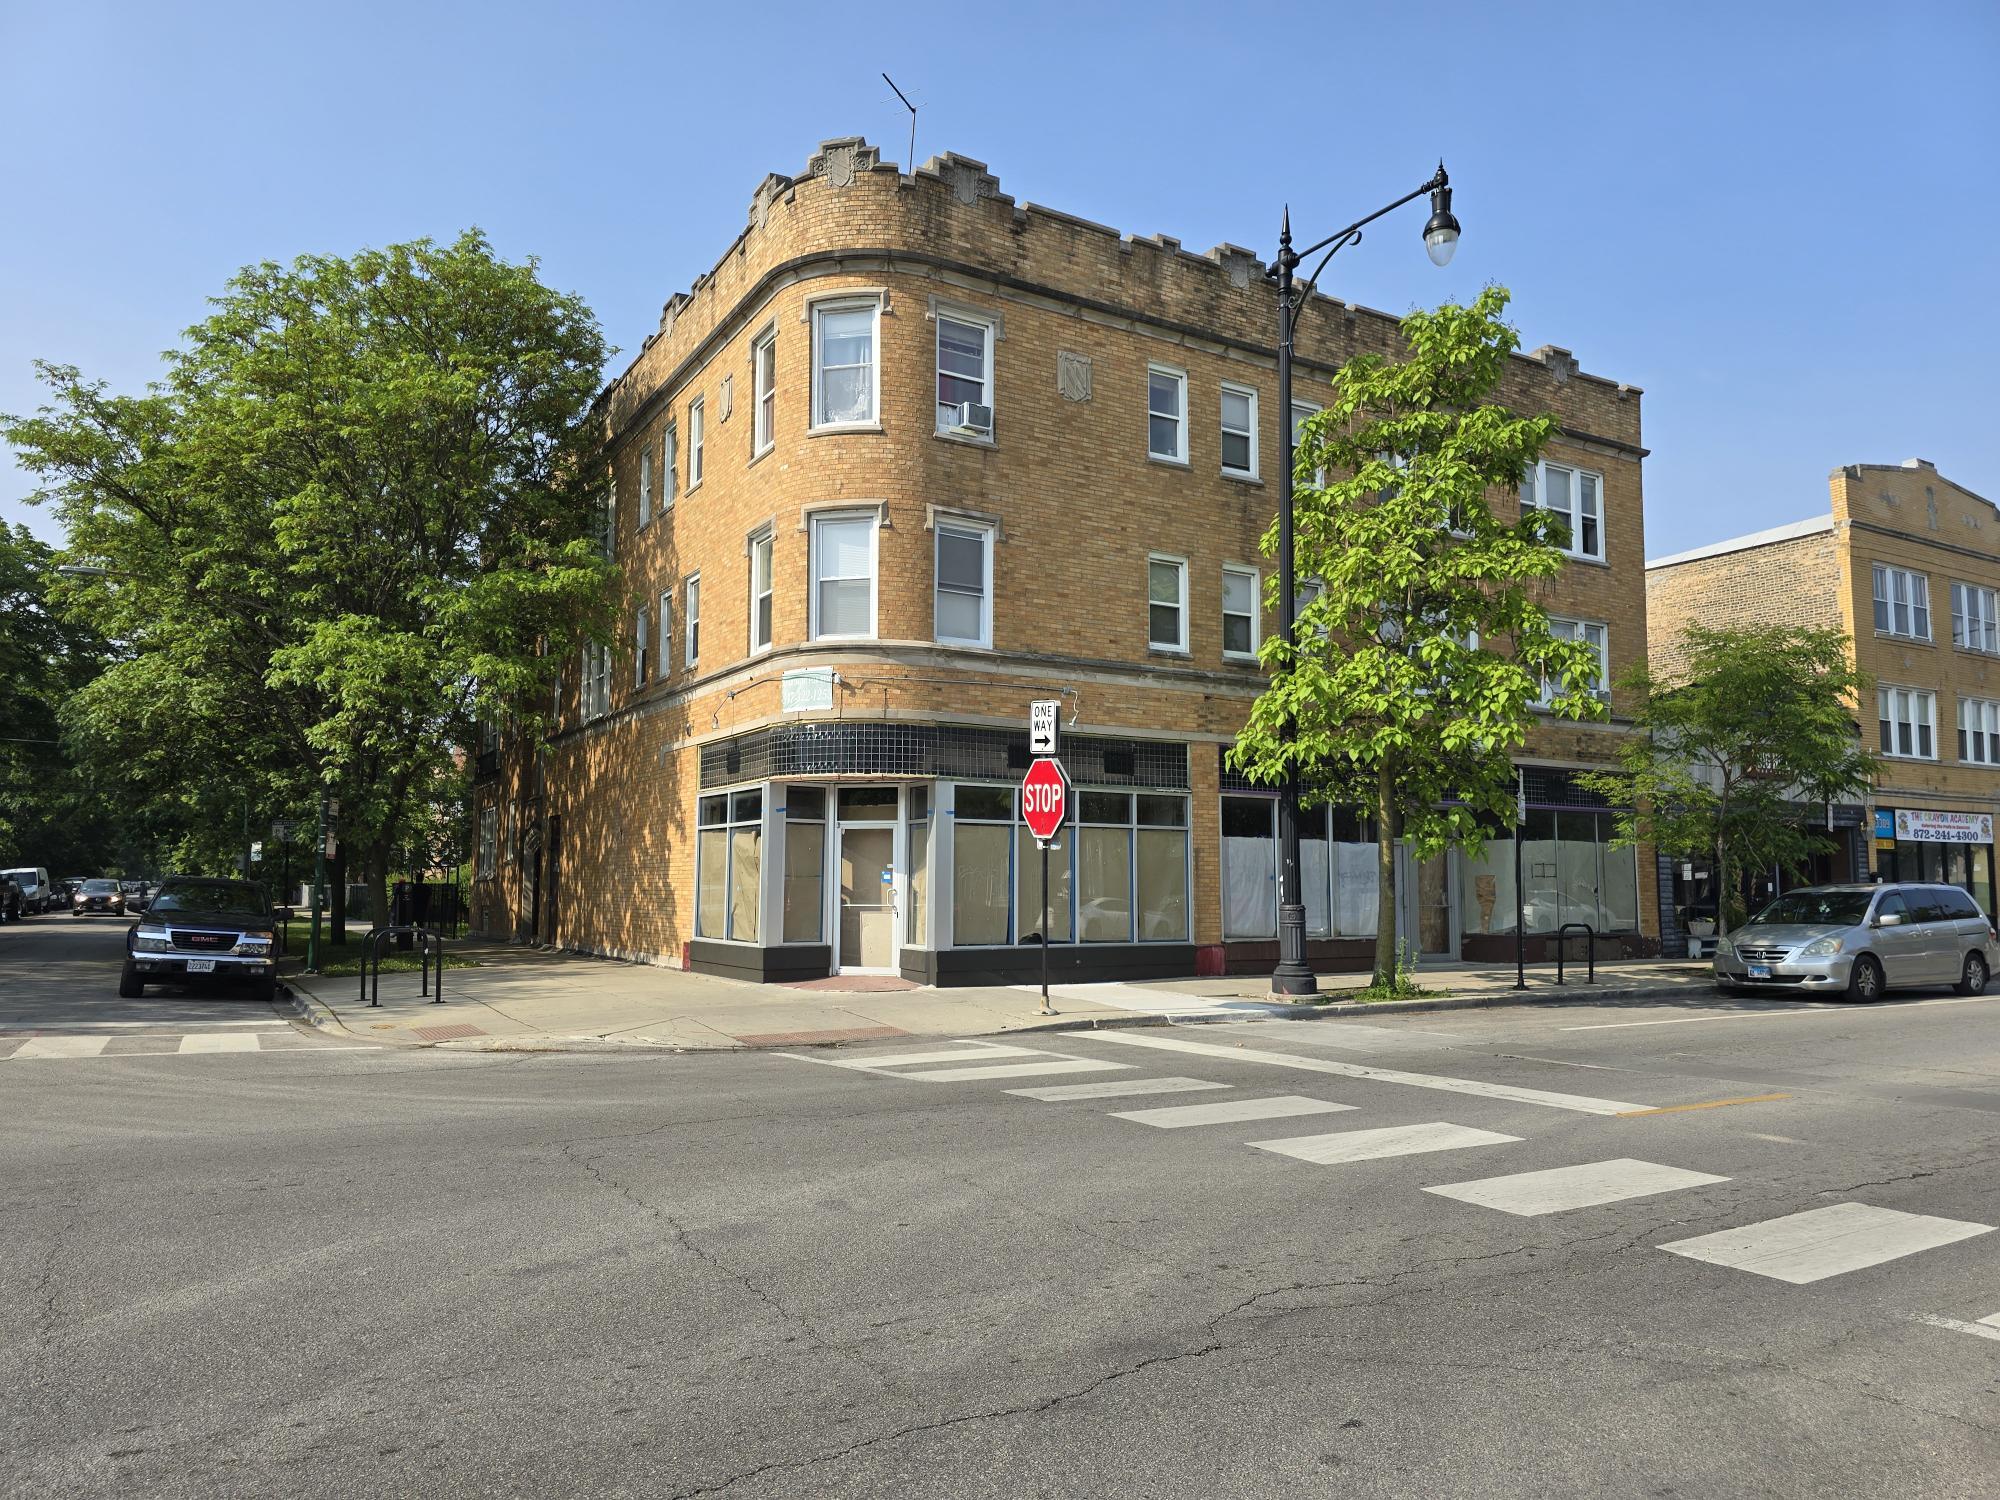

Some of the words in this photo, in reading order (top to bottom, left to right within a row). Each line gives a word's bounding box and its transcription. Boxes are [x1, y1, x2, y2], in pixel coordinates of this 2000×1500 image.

[1035, 705, 1053, 717] ONE
[1034, 719, 1053, 731] WAY
[1025, 783, 1062, 813] STOP
[1911, 811, 1924, 821] THE
[1924, 812, 1949, 823] CRAYON
[1950, 814, 1980, 825] ACADEMY
[1913, 829, 1979, 841] 872-241-4300
